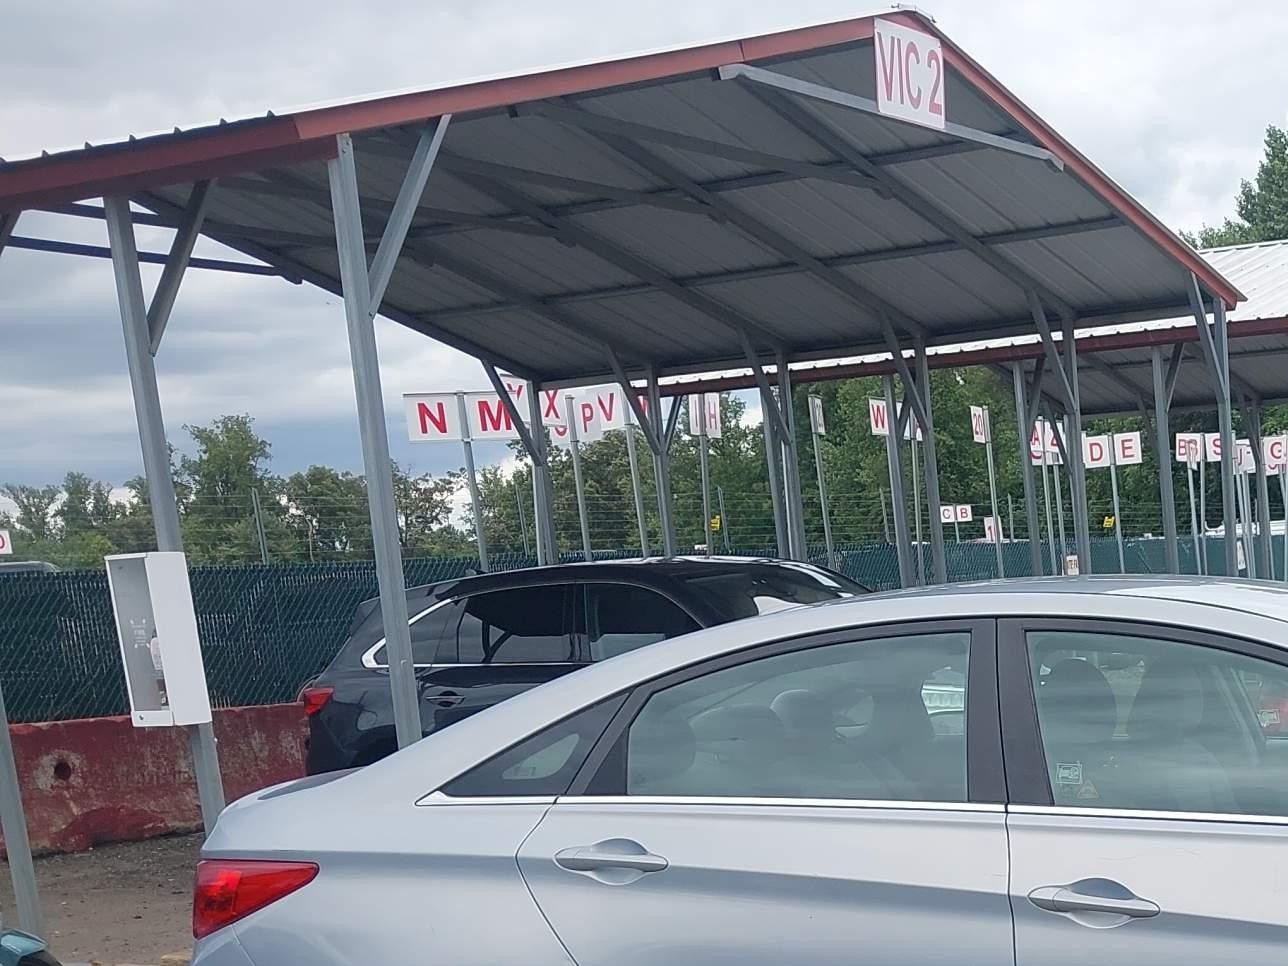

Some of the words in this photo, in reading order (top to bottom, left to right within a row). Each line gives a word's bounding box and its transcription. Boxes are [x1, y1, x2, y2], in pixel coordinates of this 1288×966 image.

[877, 31, 922, 110] VIC
[927, 49, 943, 116] 2
[417, 402, 447, 434] N
[477, 400, 512, 432] M
[544, 390, 560, 419] X
[581, 403, 594, 433] P
[598, 393, 615, 421] V
[708, 401, 718, 430] H
[871, 404, 885, 429] W
[1089, 442, 1104, 462] D
[1121, 438, 1135, 459] E
[1213, 438, 1222, 455] S
[942, 508, 951, 520] C
[960, 507, 969, 518] B
